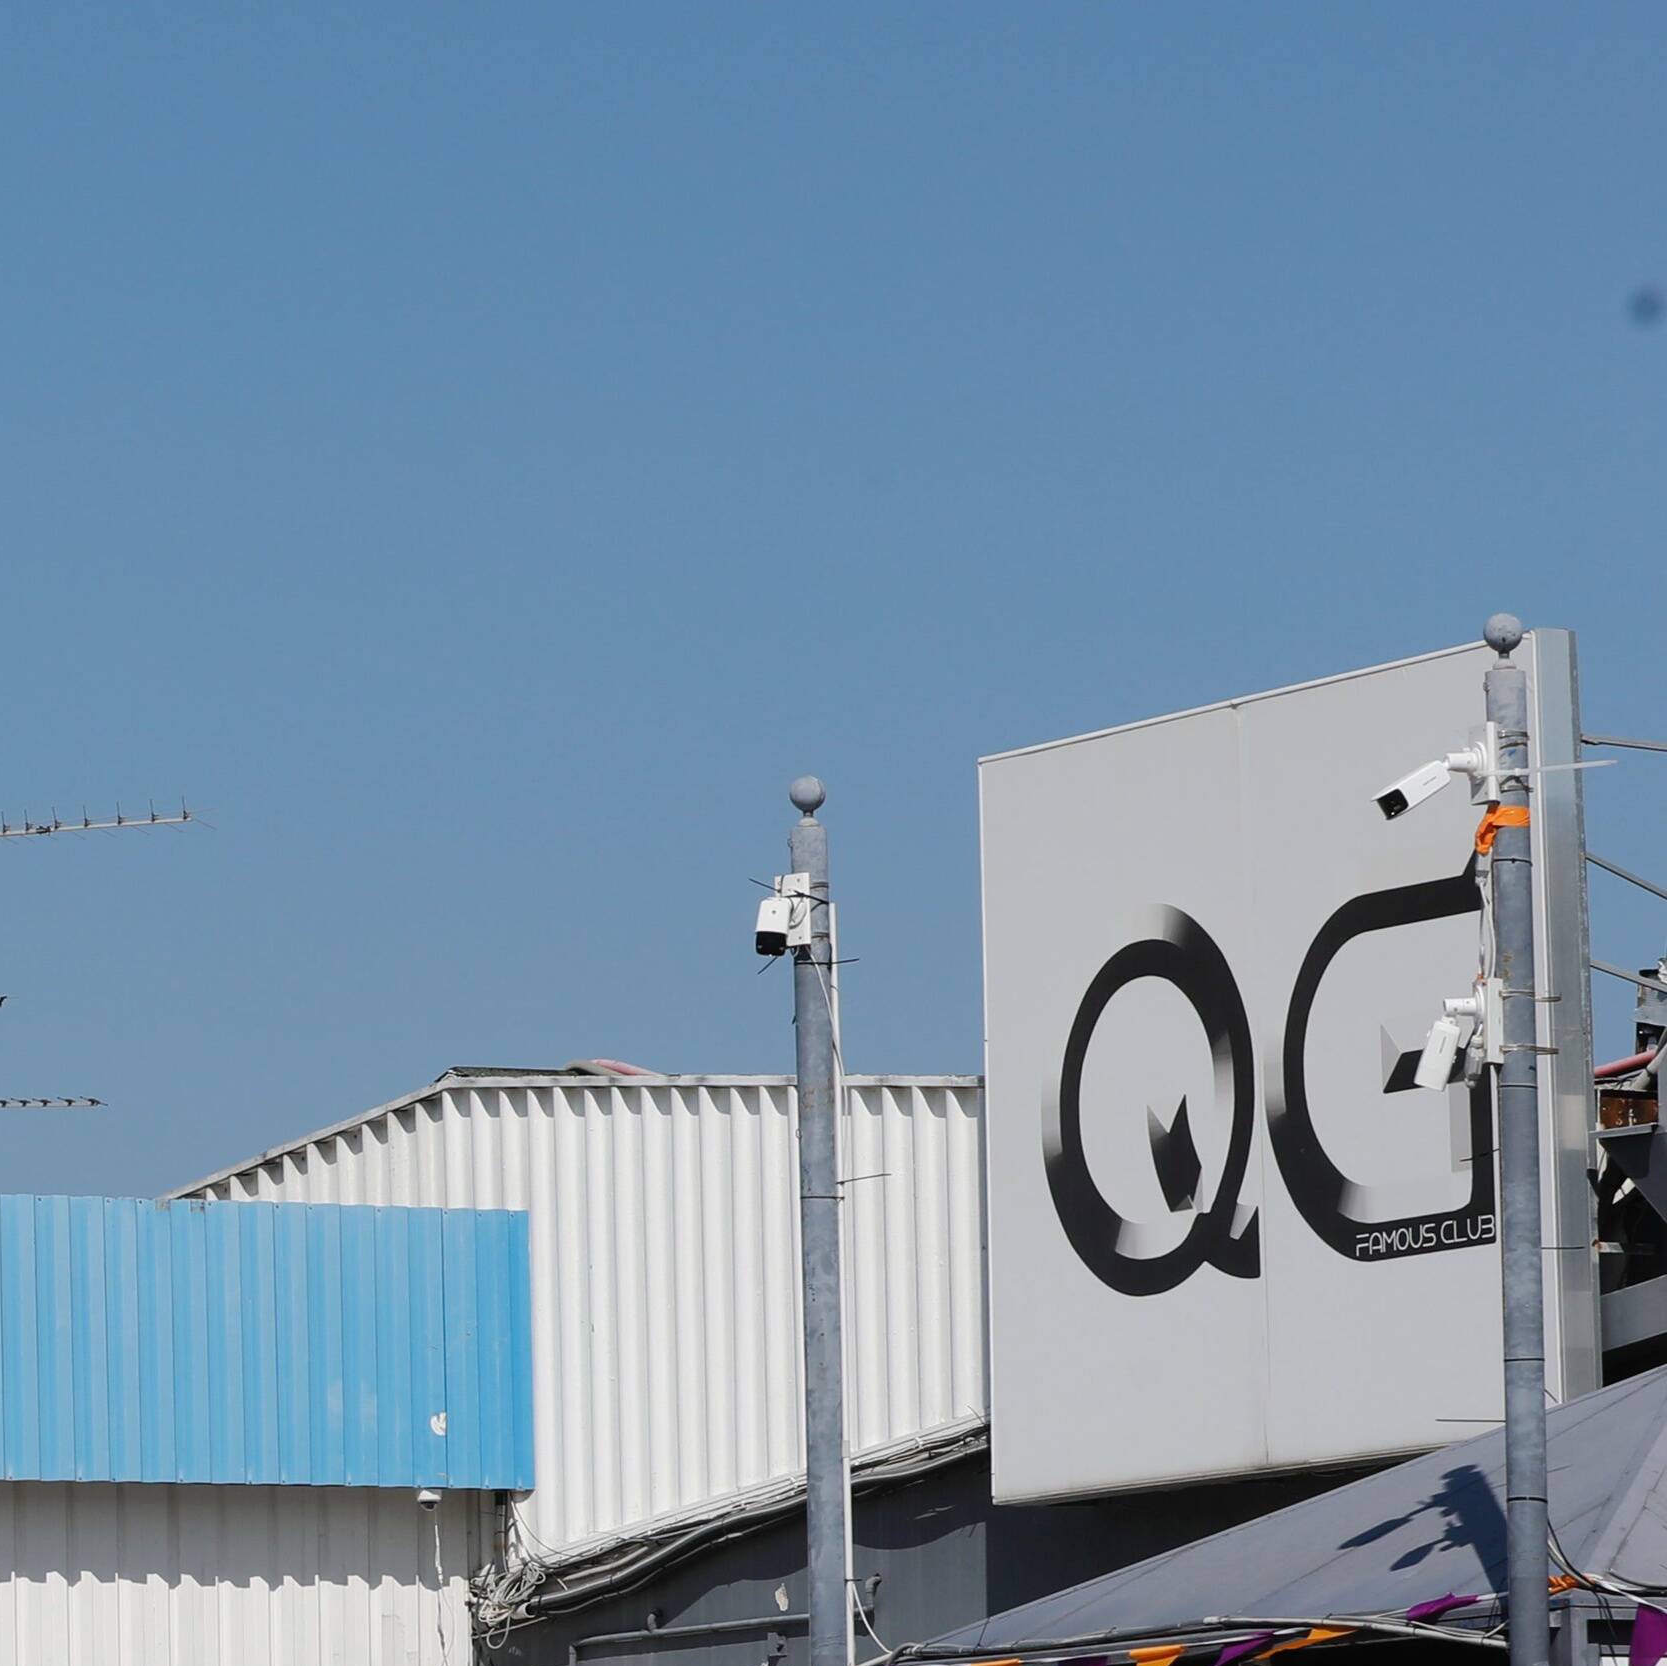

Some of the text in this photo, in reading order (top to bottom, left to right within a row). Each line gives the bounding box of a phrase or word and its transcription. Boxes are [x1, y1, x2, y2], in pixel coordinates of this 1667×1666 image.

[1041, 850, 1497, 1297] QG
[1355, 1214, 1496, 1257] FAMOUS CLUB
